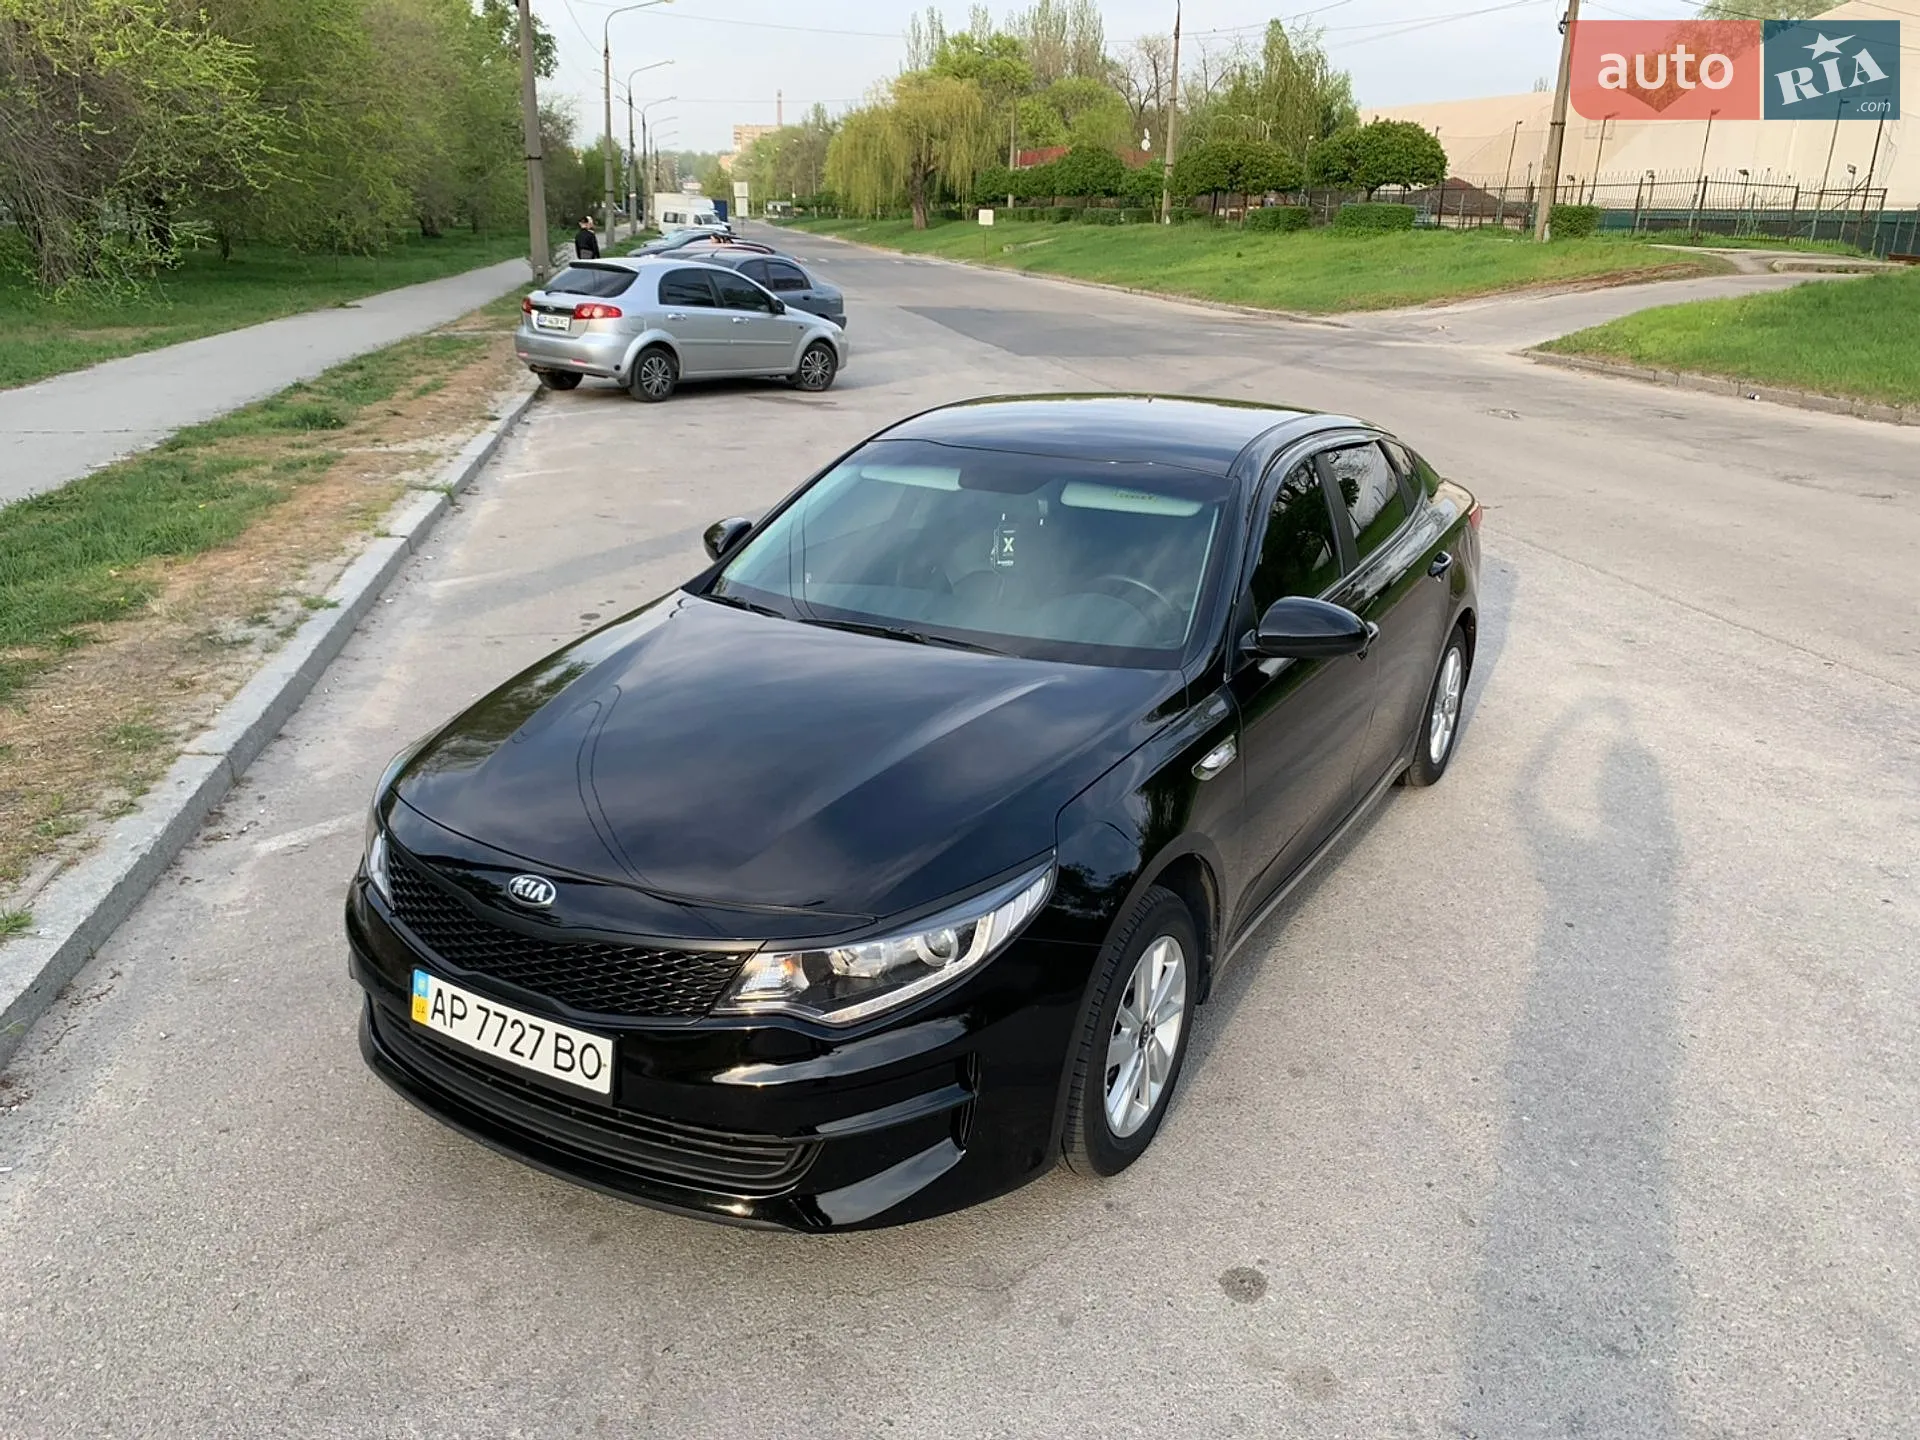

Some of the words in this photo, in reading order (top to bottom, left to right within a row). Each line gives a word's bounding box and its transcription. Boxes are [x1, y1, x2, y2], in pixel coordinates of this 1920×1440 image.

[512, 878, 547, 902] KIA
[430, 988, 468, 1029] AP
[476, 1004, 545, 1061] 7727
[553, 1032, 602, 1080] BO
